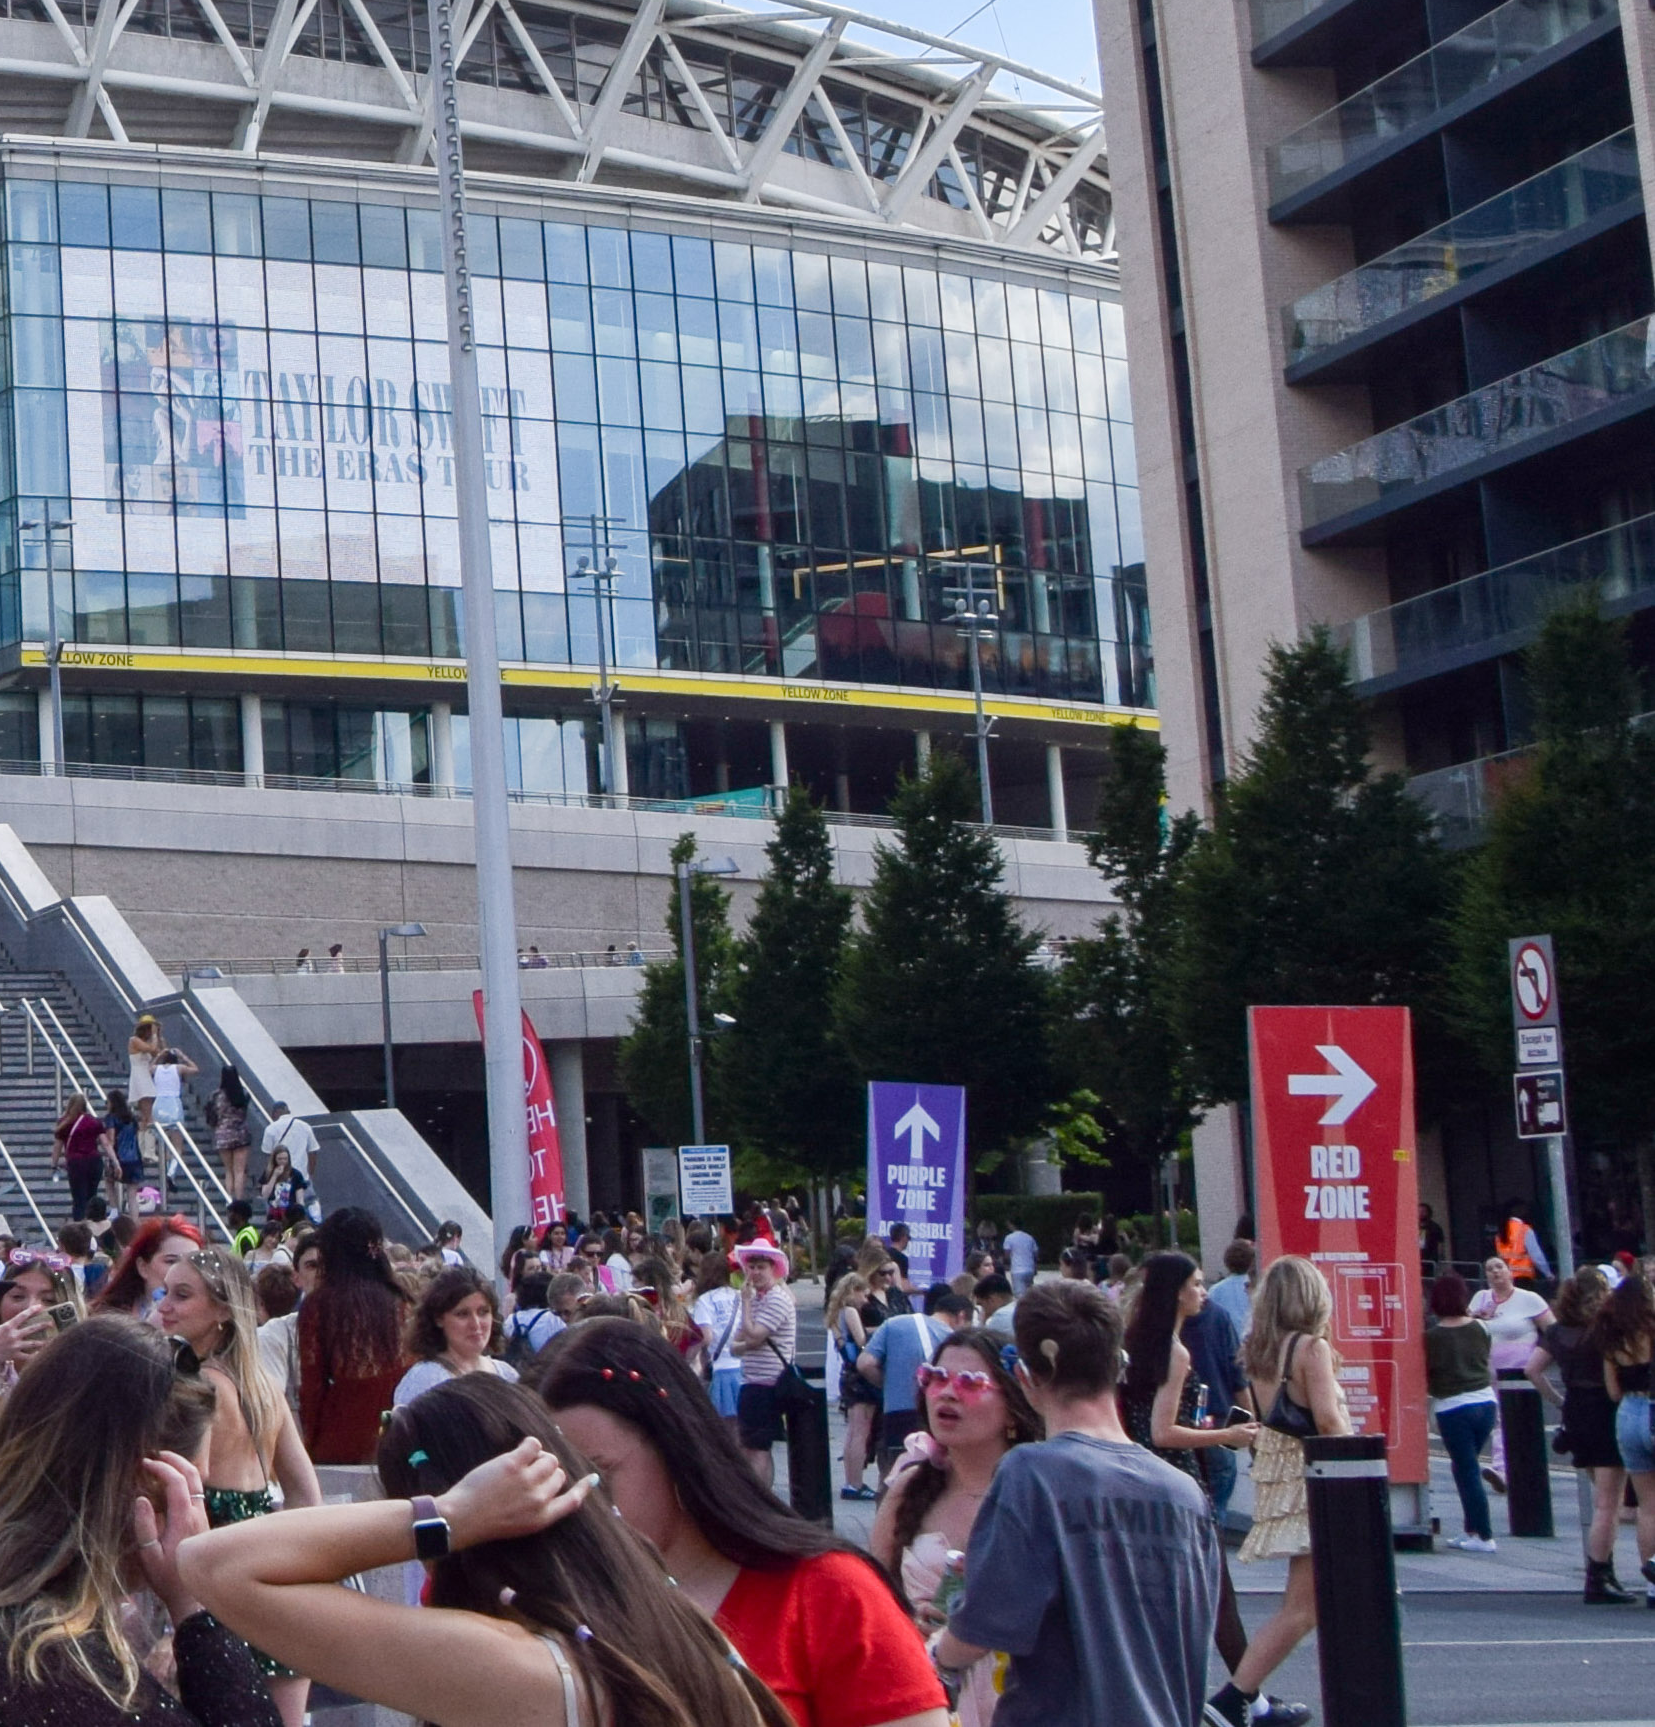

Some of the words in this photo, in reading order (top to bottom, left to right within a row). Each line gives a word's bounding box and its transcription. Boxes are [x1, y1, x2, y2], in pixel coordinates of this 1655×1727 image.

[244, 370, 401, 448] TAYLOR
[409, 380, 527, 456] SWFT
[249, 444, 323, 478] THE
[337, 450, 428, 484] ERAS
[437, 456, 530, 491] TUR
[99, 654, 134, 666] ZONE
[781, 686, 820, 699] YELLOW
[823, 688, 849, 701] ZONE
[887, 1165, 946, 1187] PURPLE
[1311, 1145, 1360, 1179] RED
[896, 1189, 936, 1210] ZONE
[1304, 1185, 1371, 1219] ZONE
